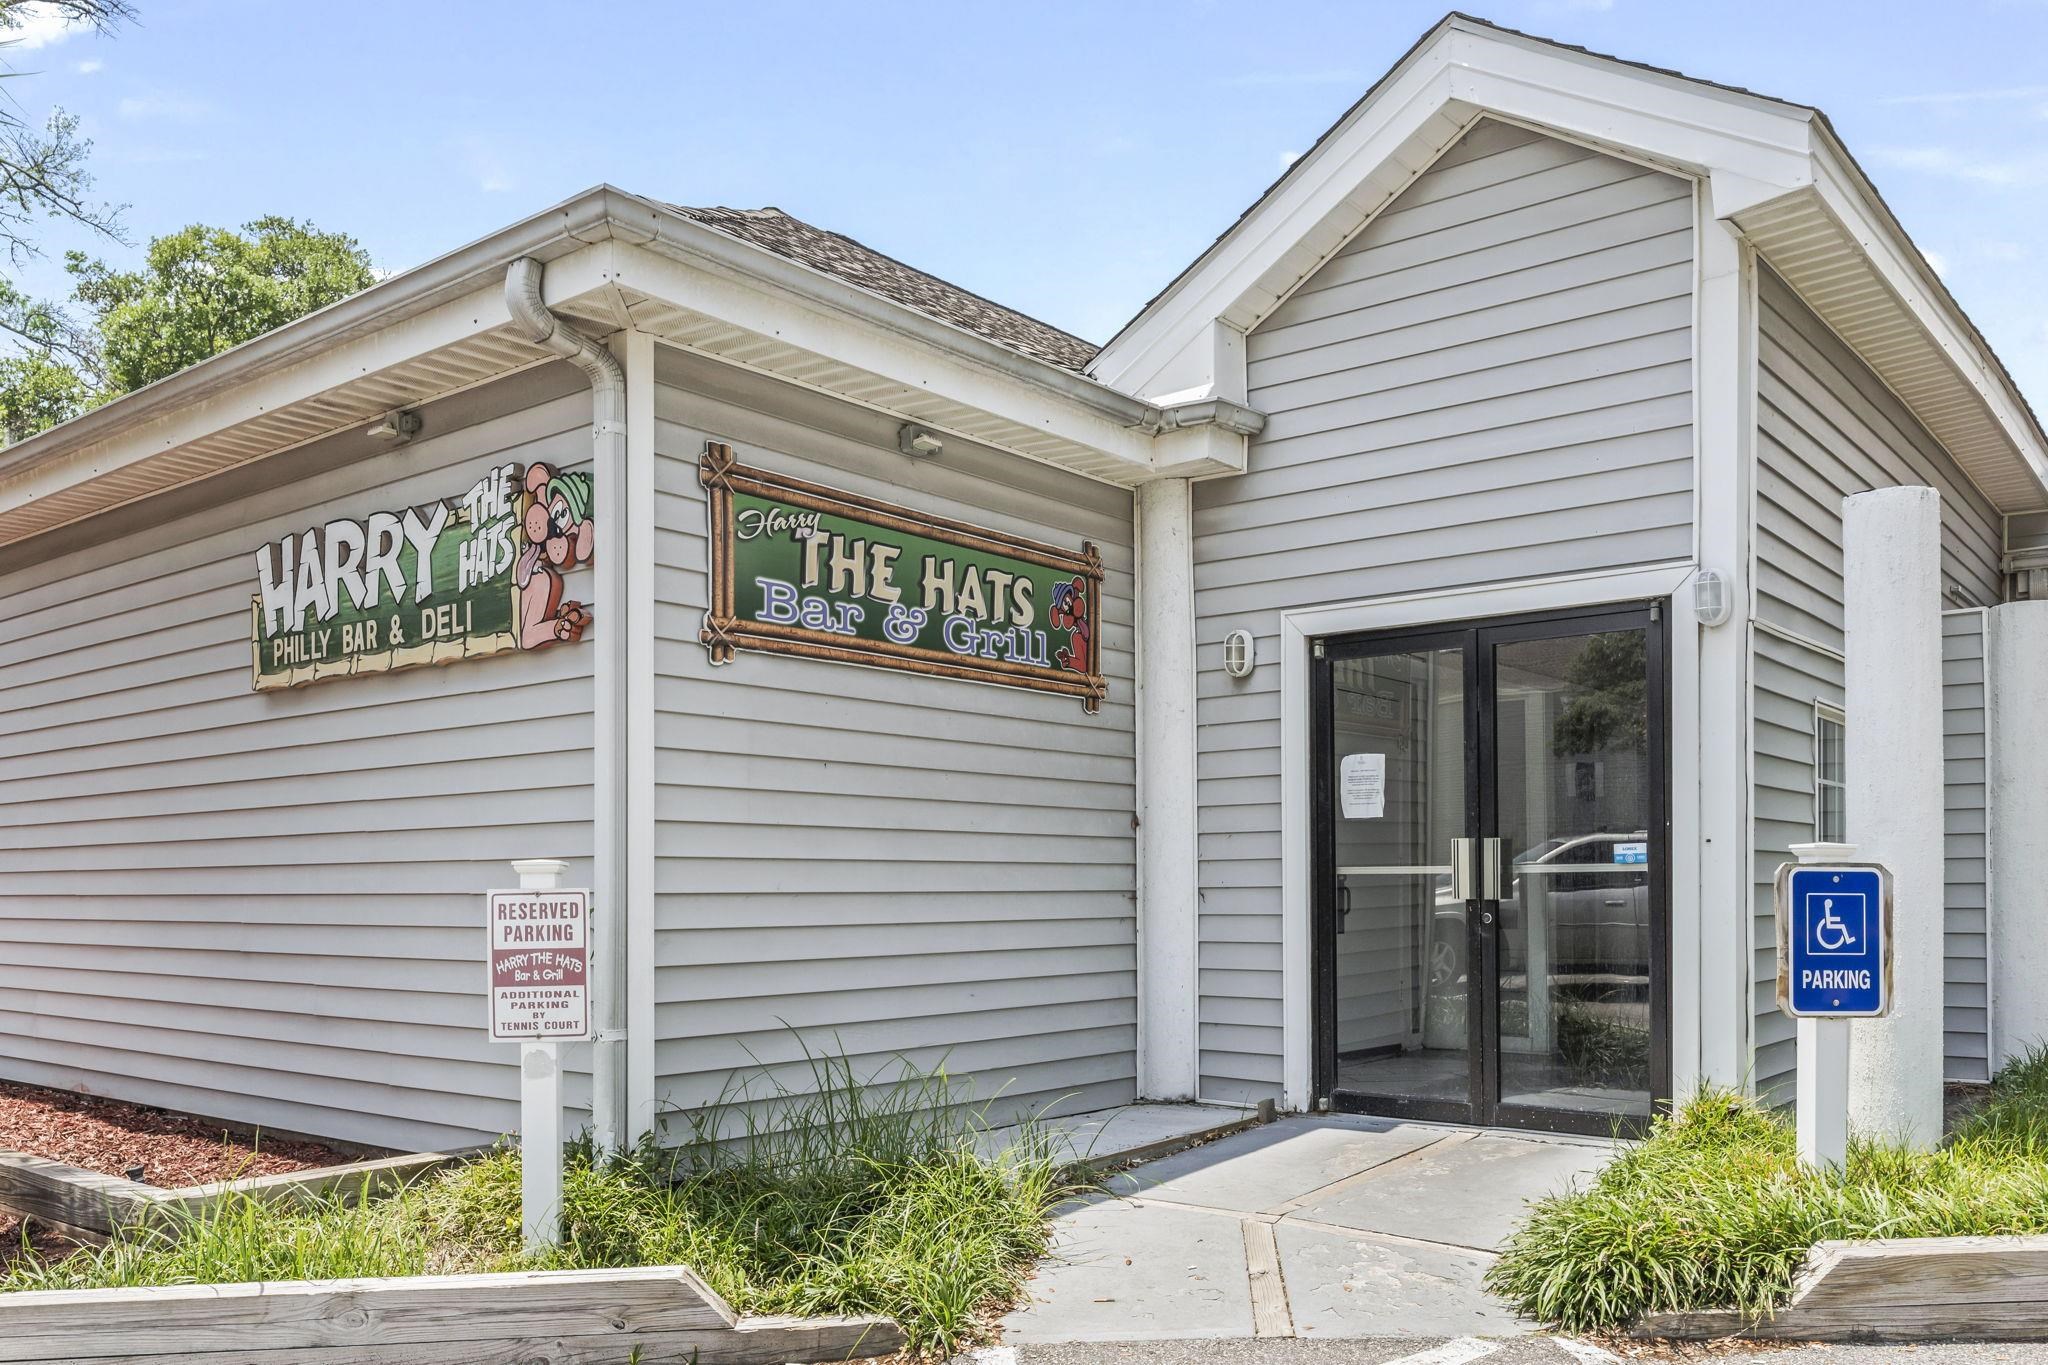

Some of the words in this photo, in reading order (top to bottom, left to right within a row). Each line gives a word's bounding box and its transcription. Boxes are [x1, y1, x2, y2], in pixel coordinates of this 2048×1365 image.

[462, 462, 515, 534] THE
[736, 508, 821, 541] Harry
[458, 515, 516, 594] HATS
[255, 498, 450, 639] HARRY
[797, 527, 903, 604] THE
[922, 555, 1036, 628] HATS
[754, 575, 865, 635] Bar
[882, 603, 928, 645] &
[943, 615, 1052, 668] Grill
[272, 628, 332, 667] PHILLY
[342, 618, 378, 655] BAR
[389, 614, 405, 644] &
[420, 599, 473, 640] DELI
[498, 902, 579, 921] RESERVED
[504, 924, 574, 942] PARKING
[495, 953, 529, 974] HARRY
[530, 952, 553, 966] THE
[555, 954, 583, 973] HATS
[514, 970, 531, 981] Bar
[533, 970, 540, 980] &
[542, 969, 563, 980] Grill
[1802, 969, 1871, 989] PARKING
[500, 990, 580, 999] ADDITIONAL
[510, 1001, 569, 1009] PARKING
[501, 1022, 539, 1031] TENNIS
[544, 1021, 579, 1030] COURT
